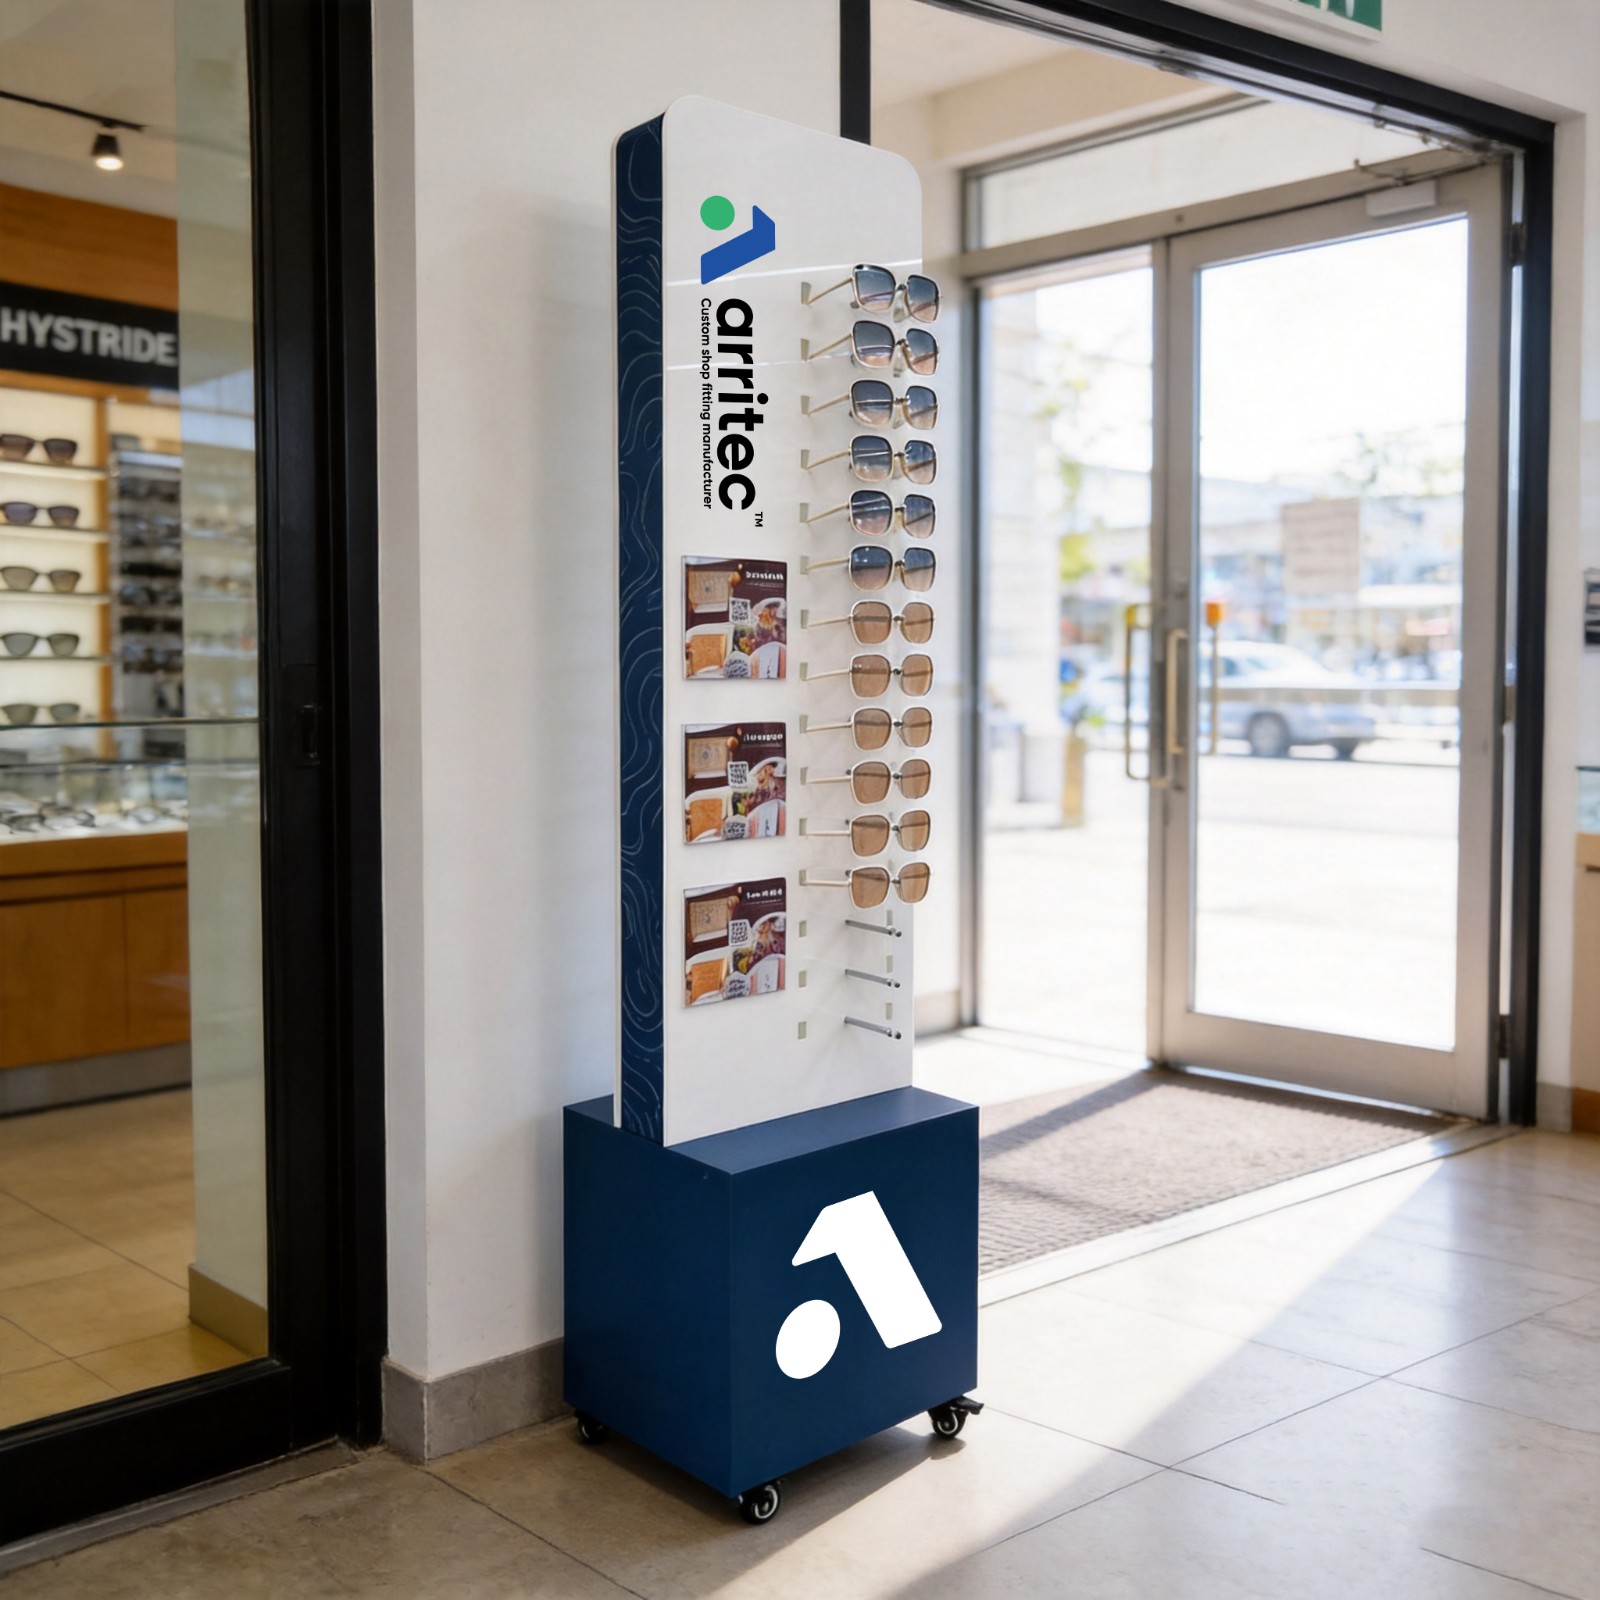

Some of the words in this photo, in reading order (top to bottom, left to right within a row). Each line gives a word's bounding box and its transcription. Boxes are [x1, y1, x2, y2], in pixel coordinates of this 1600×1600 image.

[0, 306, 178, 367] HYSTRIDE
[701, 298, 712, 346] Custom
[699, 349, 713, 380] shop
[699, 382, 713, 421] fitting
[716, 298, 769, 511] arritec
[702, 423, 714, 510] manufacturer
